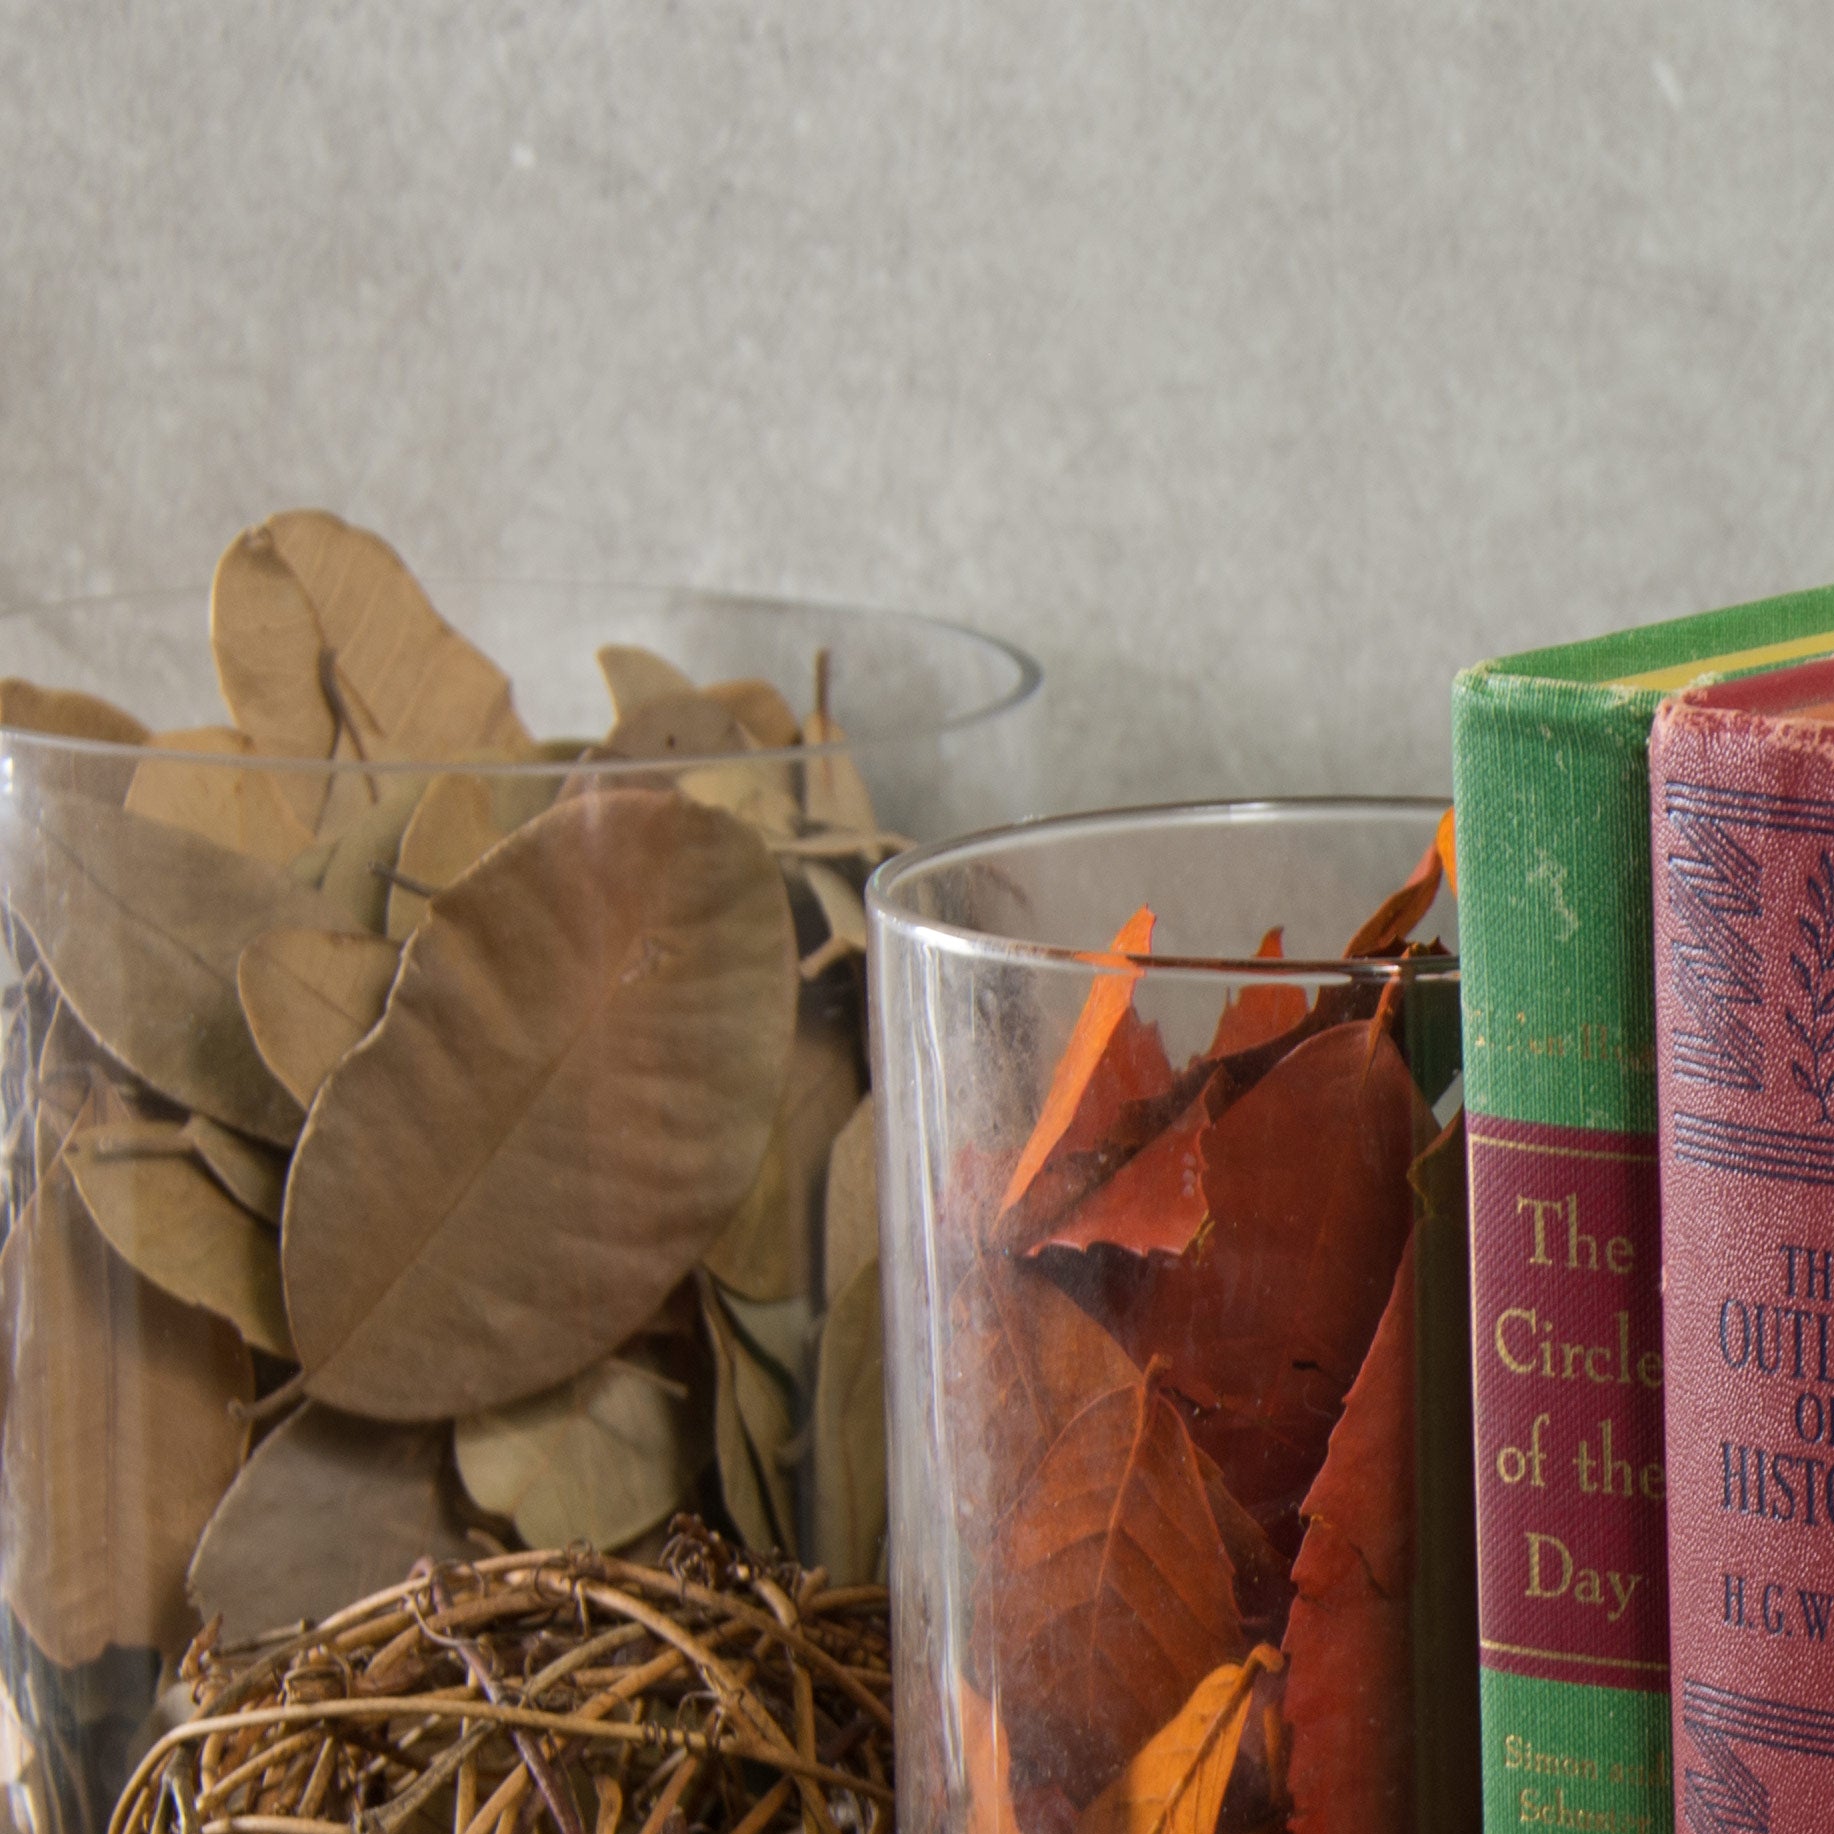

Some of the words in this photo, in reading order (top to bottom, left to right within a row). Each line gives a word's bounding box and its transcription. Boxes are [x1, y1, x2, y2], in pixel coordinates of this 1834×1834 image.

[1516, 1192, 1635, 1274] The
[1494, 1308, 1662, 1389] Circle
[1496, 1413, 1549, 1487] of
[1572, 1418, 1665, 1499] the
[1525, 1531, 1642, 1622] Day
[1504, 1733, 1599, 1782] Simon
